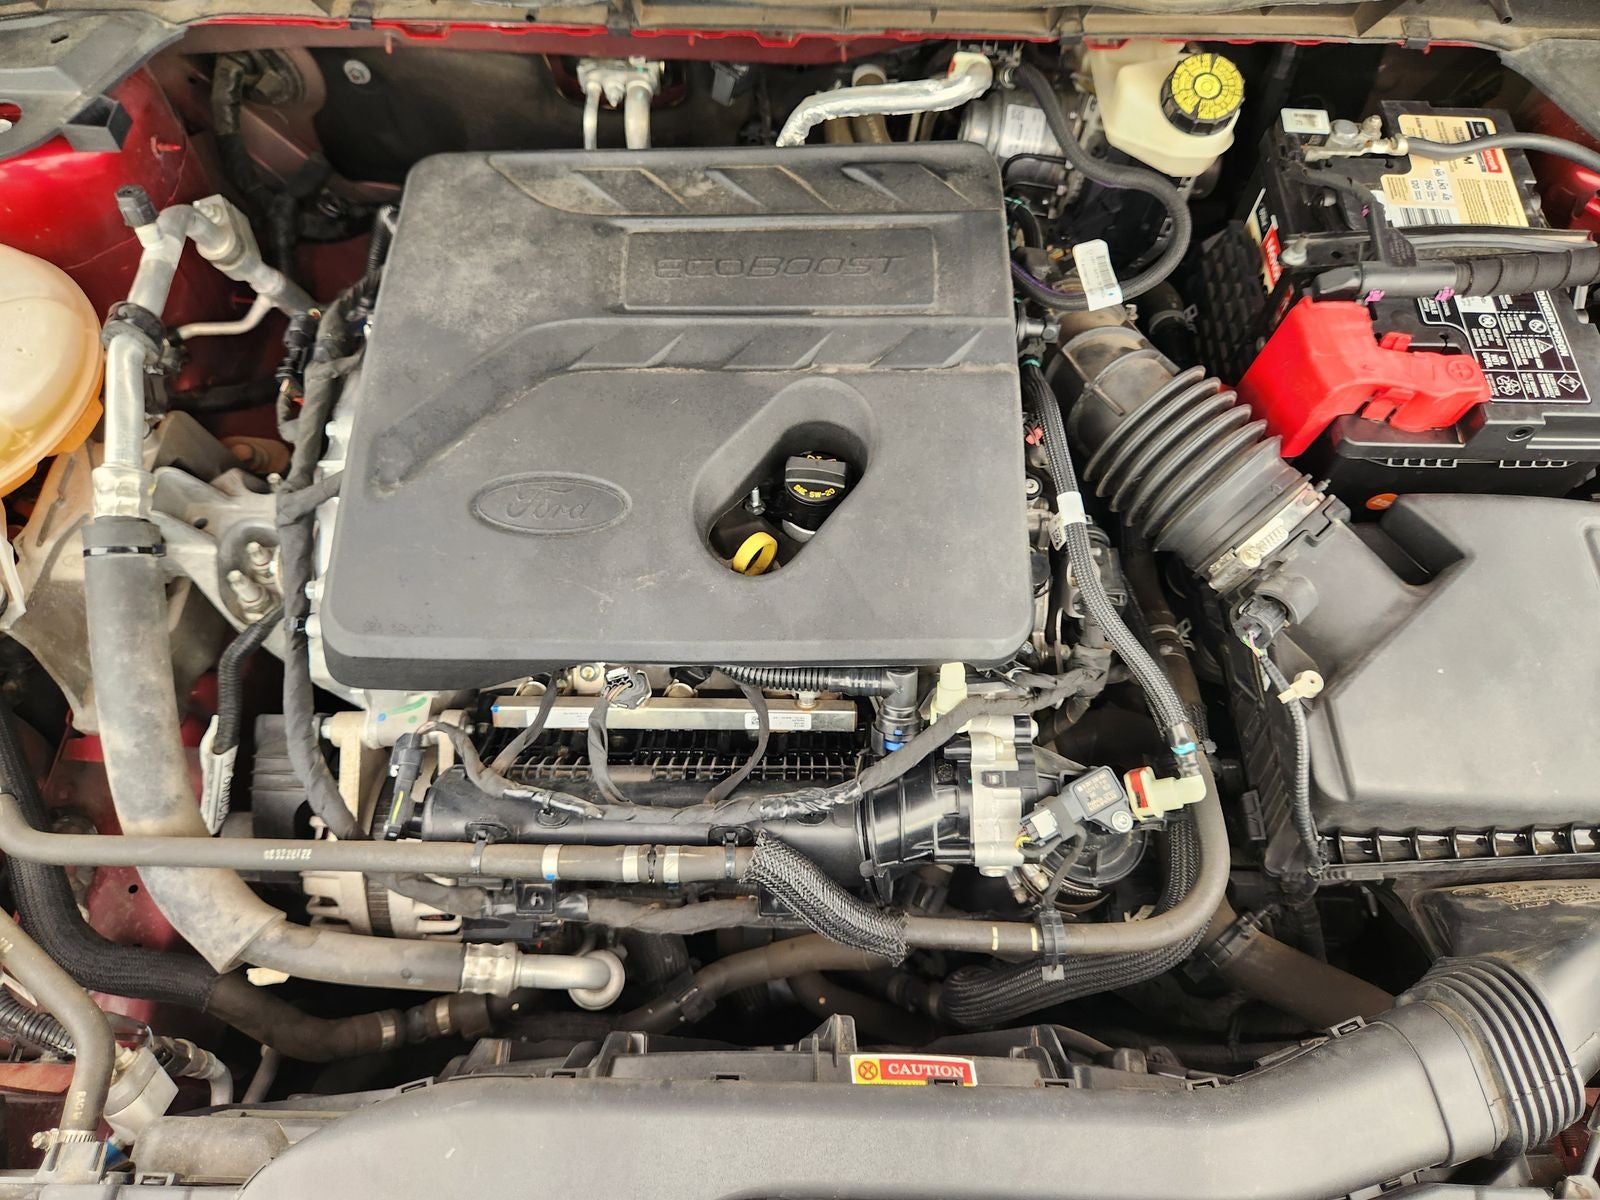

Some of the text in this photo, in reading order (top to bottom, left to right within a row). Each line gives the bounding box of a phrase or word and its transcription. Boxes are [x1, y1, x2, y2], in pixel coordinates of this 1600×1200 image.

[1537, 290, 1570, 357] DANGER/POISON
[793, 484, 836, 498] SAE 5W-20
[506, 487, 592, 520] Ford
[888, 1063, 964, 1078] CAUTION
